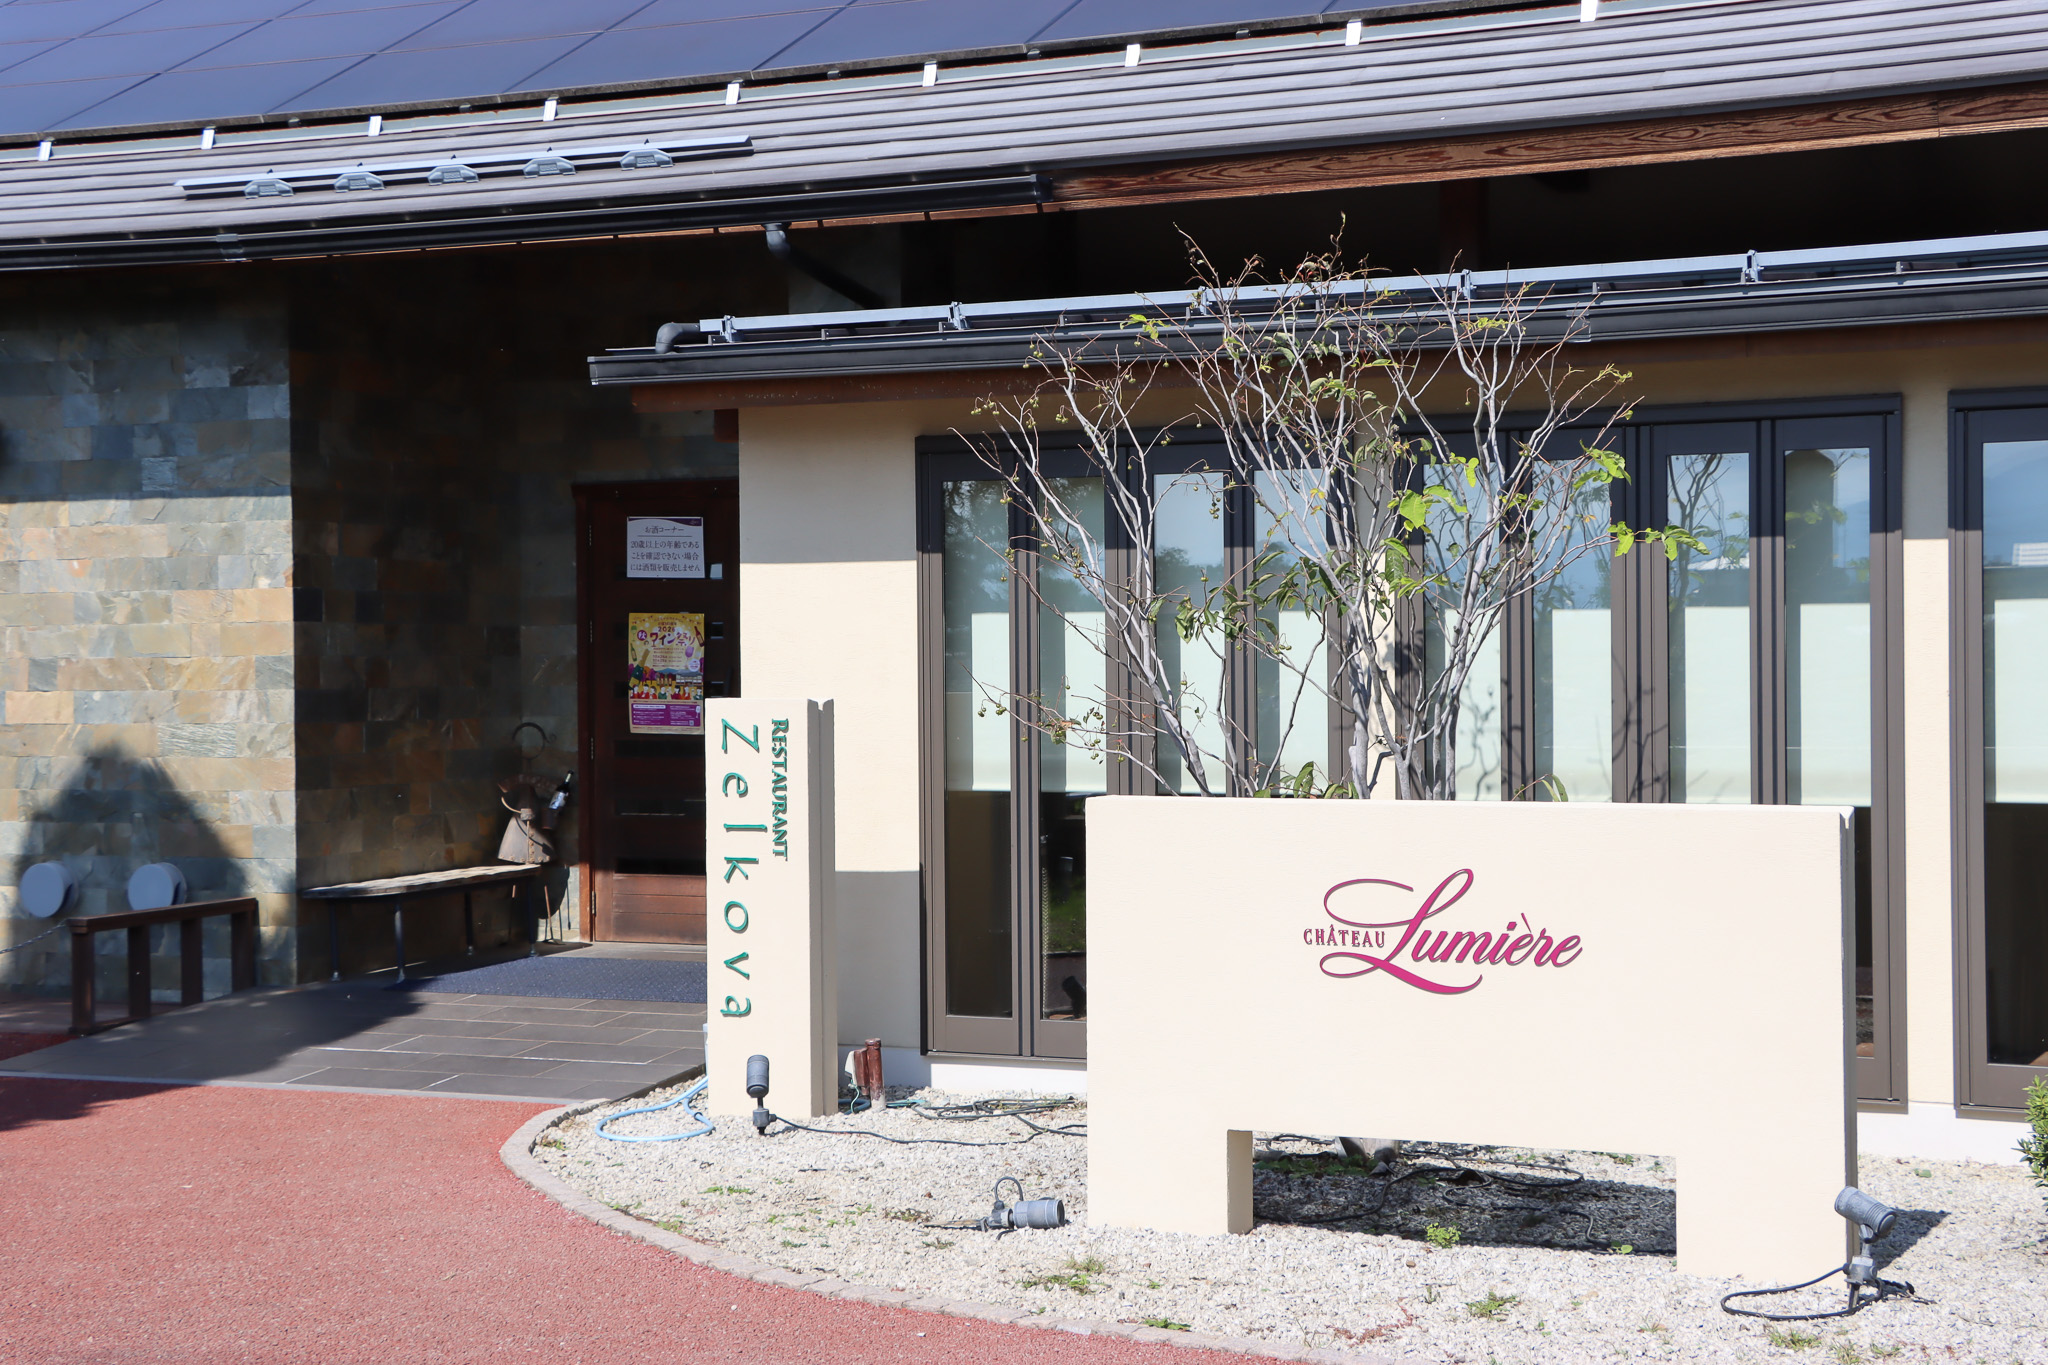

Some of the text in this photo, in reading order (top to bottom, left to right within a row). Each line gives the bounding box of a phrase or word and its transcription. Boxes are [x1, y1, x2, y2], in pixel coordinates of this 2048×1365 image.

[644, 526, 685, 534] お酒コーナー
[630, 540, 700, 549] 20歳以上の年齢である
[631, 552, 700, 560] ことを確認できない場合
[630, 563, 701, 572] には酒類を販売しません
[771, 718, 790, 861] RESTAURANT
[720, 717, 768, 1017] Zelkova
[1303, 868, 1583, 995] CHÂTEAU Lumière
